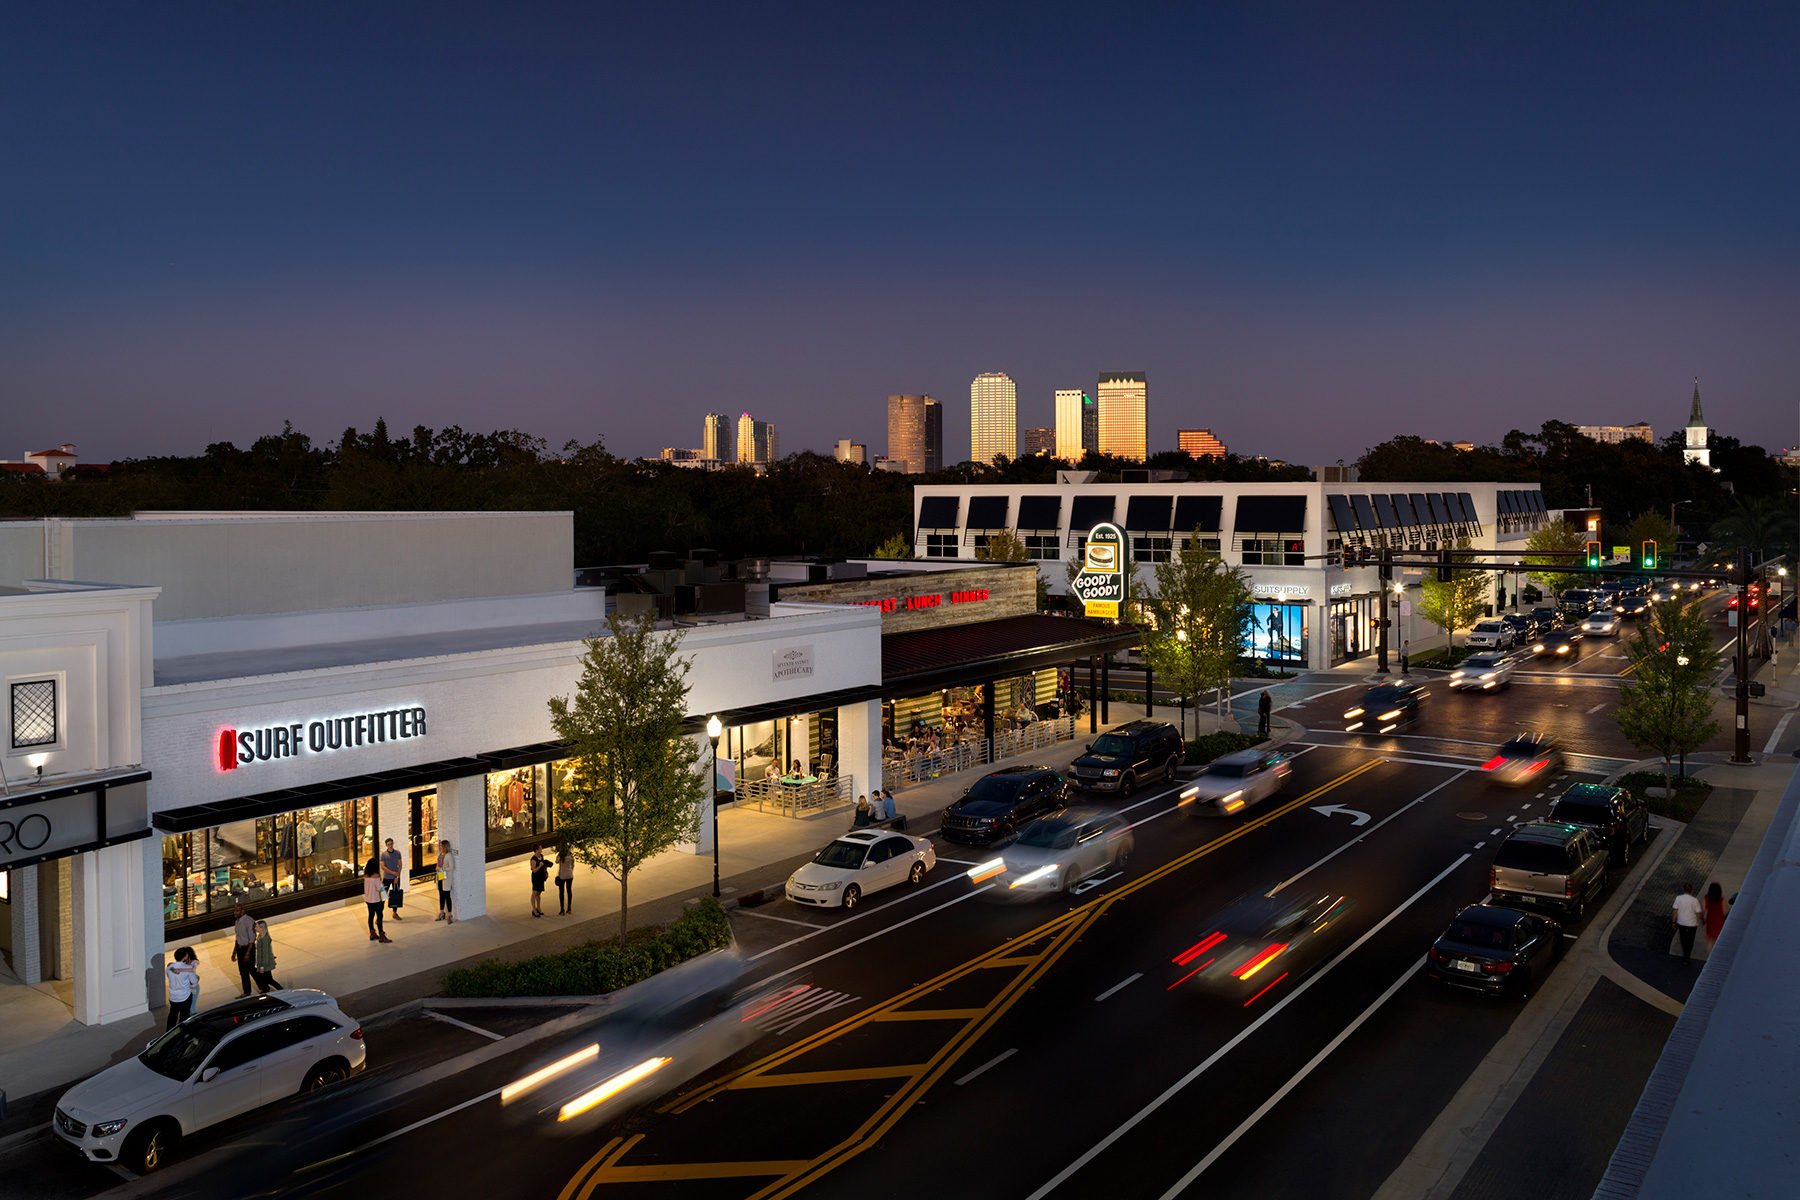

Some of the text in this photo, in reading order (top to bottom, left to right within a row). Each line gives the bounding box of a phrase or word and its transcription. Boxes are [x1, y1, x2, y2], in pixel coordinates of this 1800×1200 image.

[1076, 574, 1112, 588] GOODY
[1083, 585, 1119, 598] GOODY
[1254, 585, 1309, 595] SUITSUPPLY
[907, 594, 942, 610] LUNCH
[952, 589, 990, 604] DINNER
[773, 667, 813, 678] APOTHECARY
[238, 707, 426, 763] SURF OUTFITTER
